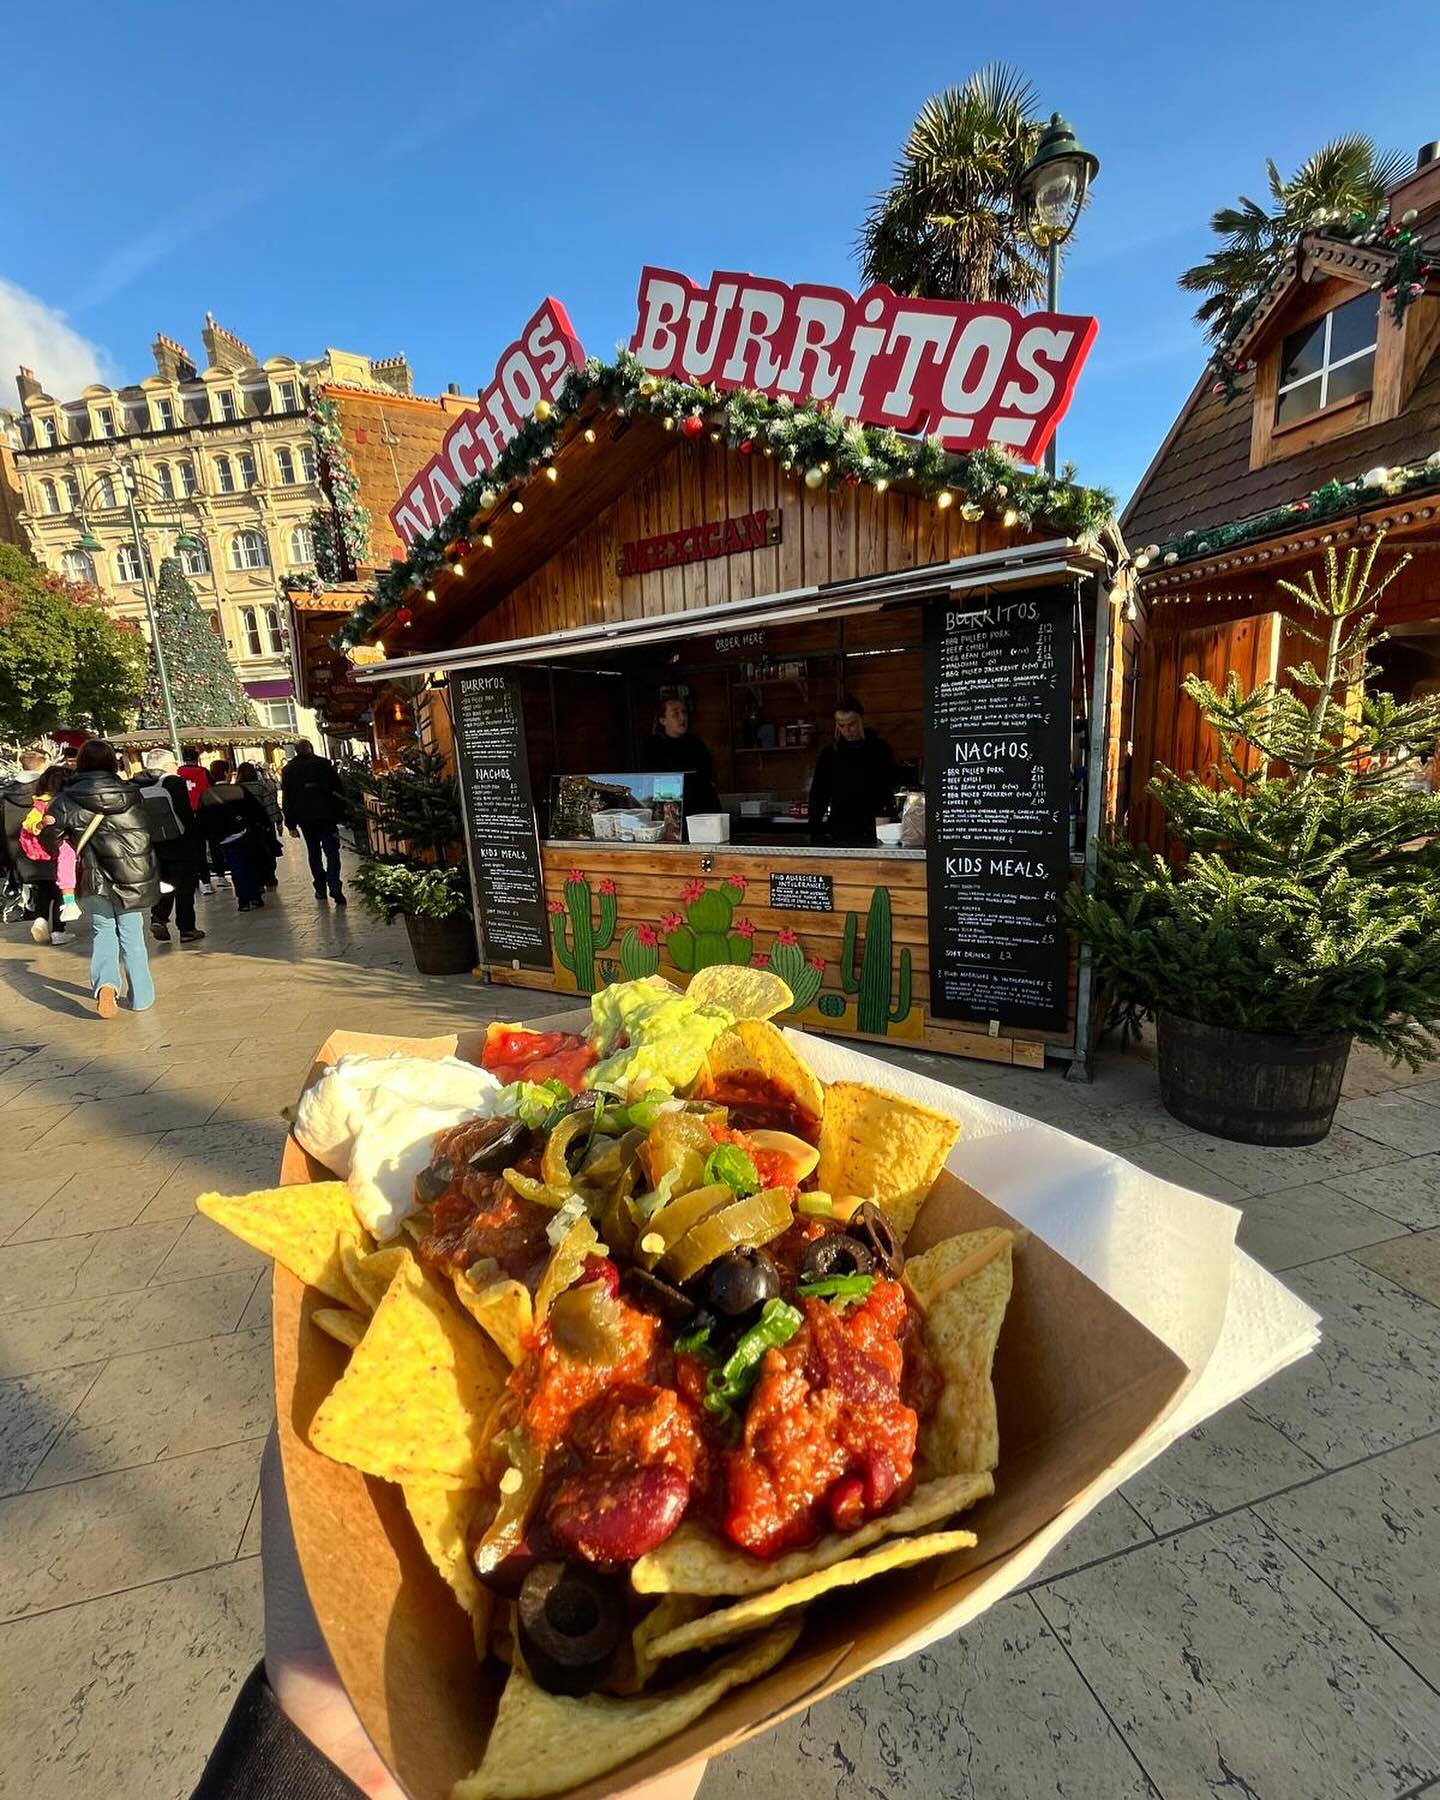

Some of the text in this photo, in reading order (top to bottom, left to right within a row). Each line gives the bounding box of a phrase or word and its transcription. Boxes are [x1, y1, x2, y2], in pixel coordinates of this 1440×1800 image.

[396, 313, 567, 543] NACHOS
[619, 509, 768, 576] MEXICAN
[946, 602, 1037, 631] BURRITOS
[715, 632, 764, 650] ORDER HERE
[961, 633, 987, 644] PULLED
[990, 630, 1011, 640] PORK
[946, 645, 962, 654] BEEF
[965, 642, 989, 651] CHILLI
[961, 652, 979, 660] BEAN
[981, 649, 1003, 658] CHILLI
[945, 670, 960, 678] BBQ
[962, 667, 982, 676] PULLED
[984, 664, 1019, 674] JACKFRUIT
[461, 677, 505, 693] BURRITOS
[955, 741, 1028, 762] NACHOS
[475, 768, 510, 780] NACHOS
[947, 765, 1045, 776] BBQ PULLED PORK £12
[1031, 774, 1044, 782] £11
[1031, 782, 1044, 790] £11
[1030, 797, 1045, 806] £10
[480, 848, 526, 860] KIDS MEALS
[946, 857, 1045, 878] KIDS MEALS
[1043, 891, 1056, 900] £6
[1045, 914, 1057, 923] £5
[1041, 934, 1055, 944] £5
[945, 950, 1012, 961] SOFT DRINKS £2
